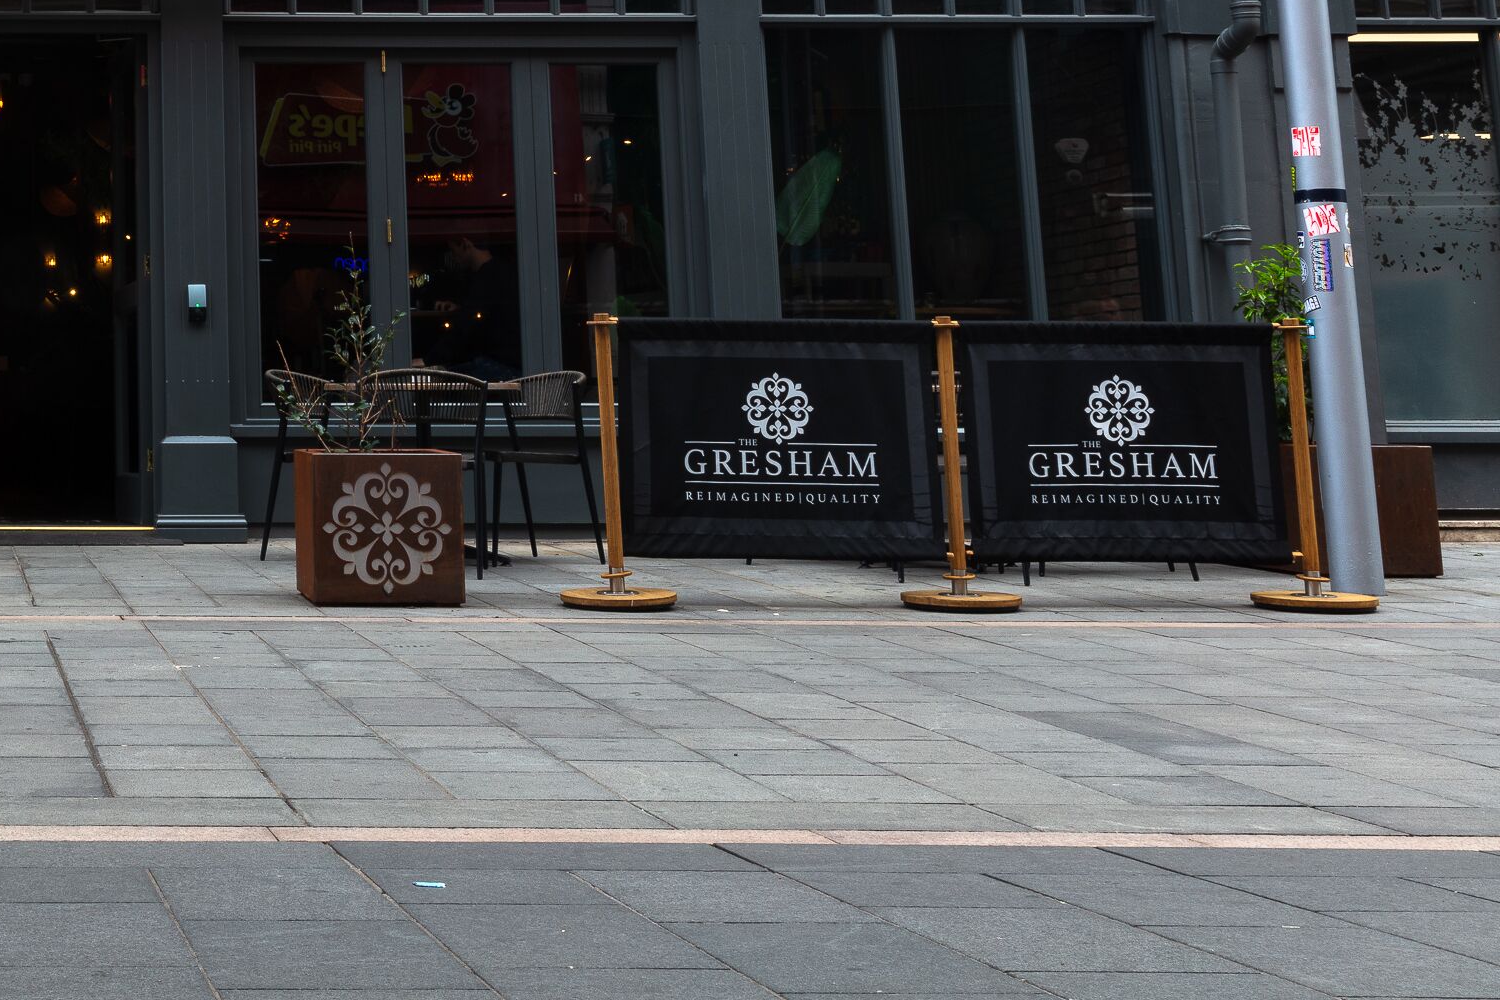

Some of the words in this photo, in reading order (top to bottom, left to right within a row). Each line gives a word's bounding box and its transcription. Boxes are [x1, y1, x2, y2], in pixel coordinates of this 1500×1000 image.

[738, 438, 758, 447] THE
[1081, 440, 1101, 448] THE
[684, 448, 879, 478] GRESHAM
[1028, 451, 1219, 479] GRESHAM
